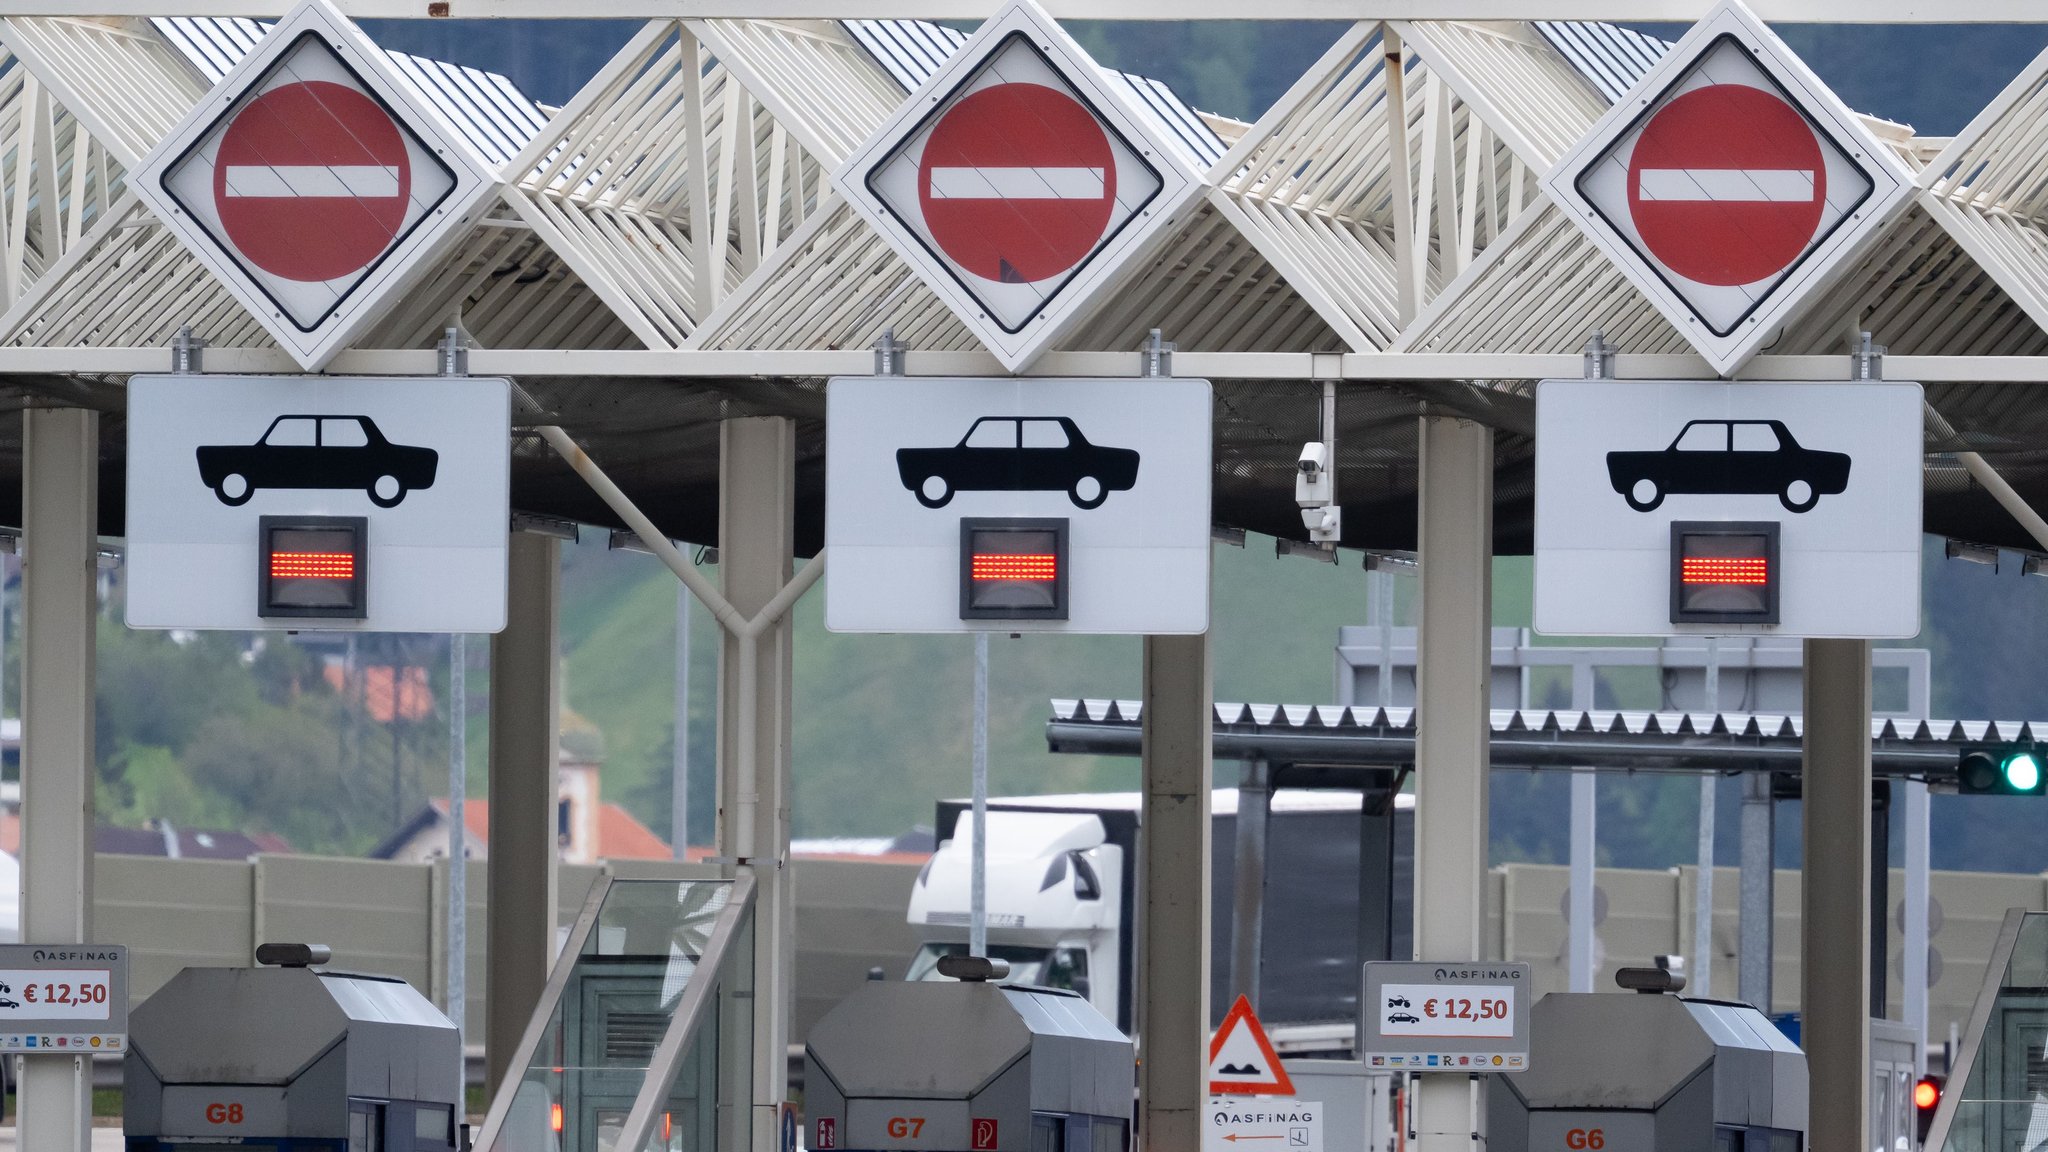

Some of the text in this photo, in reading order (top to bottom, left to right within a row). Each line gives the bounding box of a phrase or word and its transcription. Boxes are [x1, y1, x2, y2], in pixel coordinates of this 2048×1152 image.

[23, 983, 107, 1007] € 12,50
[1423, 998, 1508, 1022] € 12,50
[206, 1102, 244, 1124] G8
[1231, 1112, 1313, 1123] ASFiNAG
[887, 1116, 926, 1138] G7
[1566, 1127, 1604, 1150] G6
